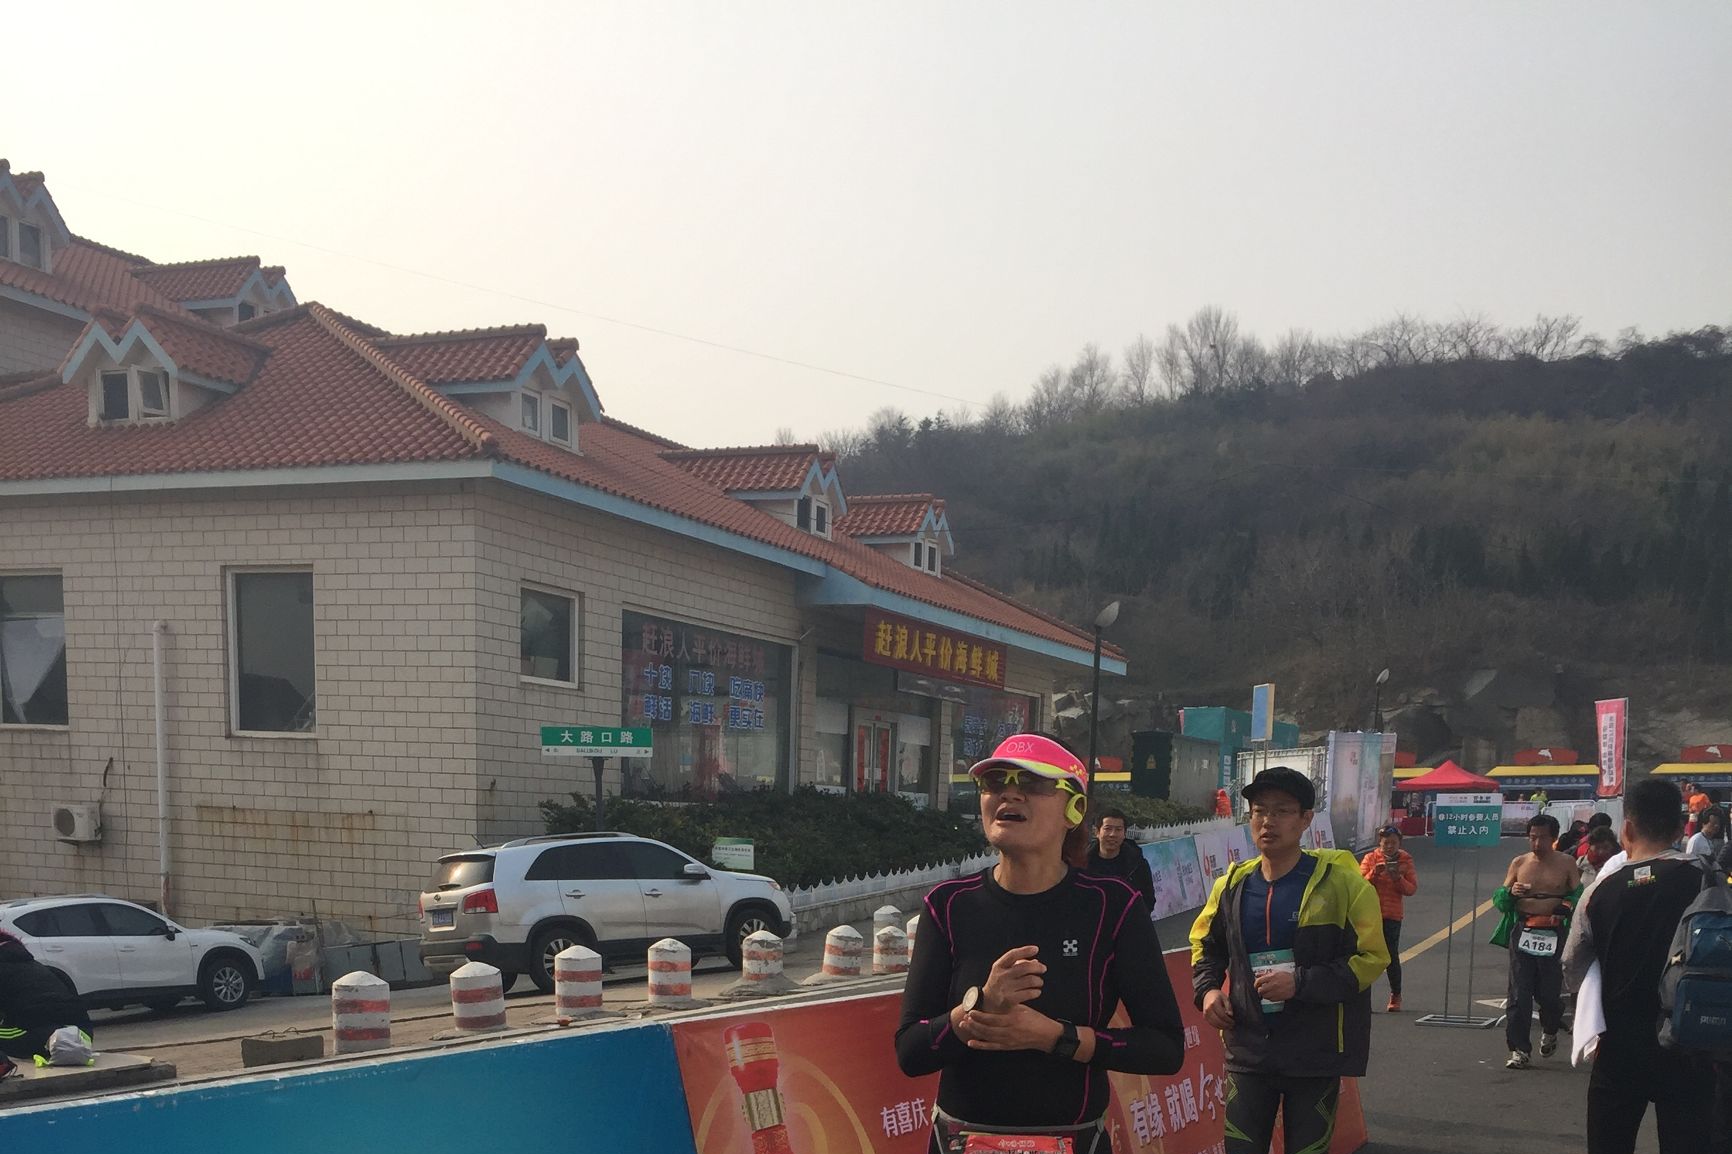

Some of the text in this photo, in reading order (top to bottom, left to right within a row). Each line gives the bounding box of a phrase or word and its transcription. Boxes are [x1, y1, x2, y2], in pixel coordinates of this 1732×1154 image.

[560, 730, 634, 744] 大路口路
[1006, 741, 1034, 754] OBX
[1447, 825, 1489, 835] 禁止入内
[1522, 939, 1553, 952] A184
[880, 1098, 929, 1138] 有喜庆
[1130, 1093, 1167, 1148] 有缘
[1164, 1077, 1199, 1133] 就喝
